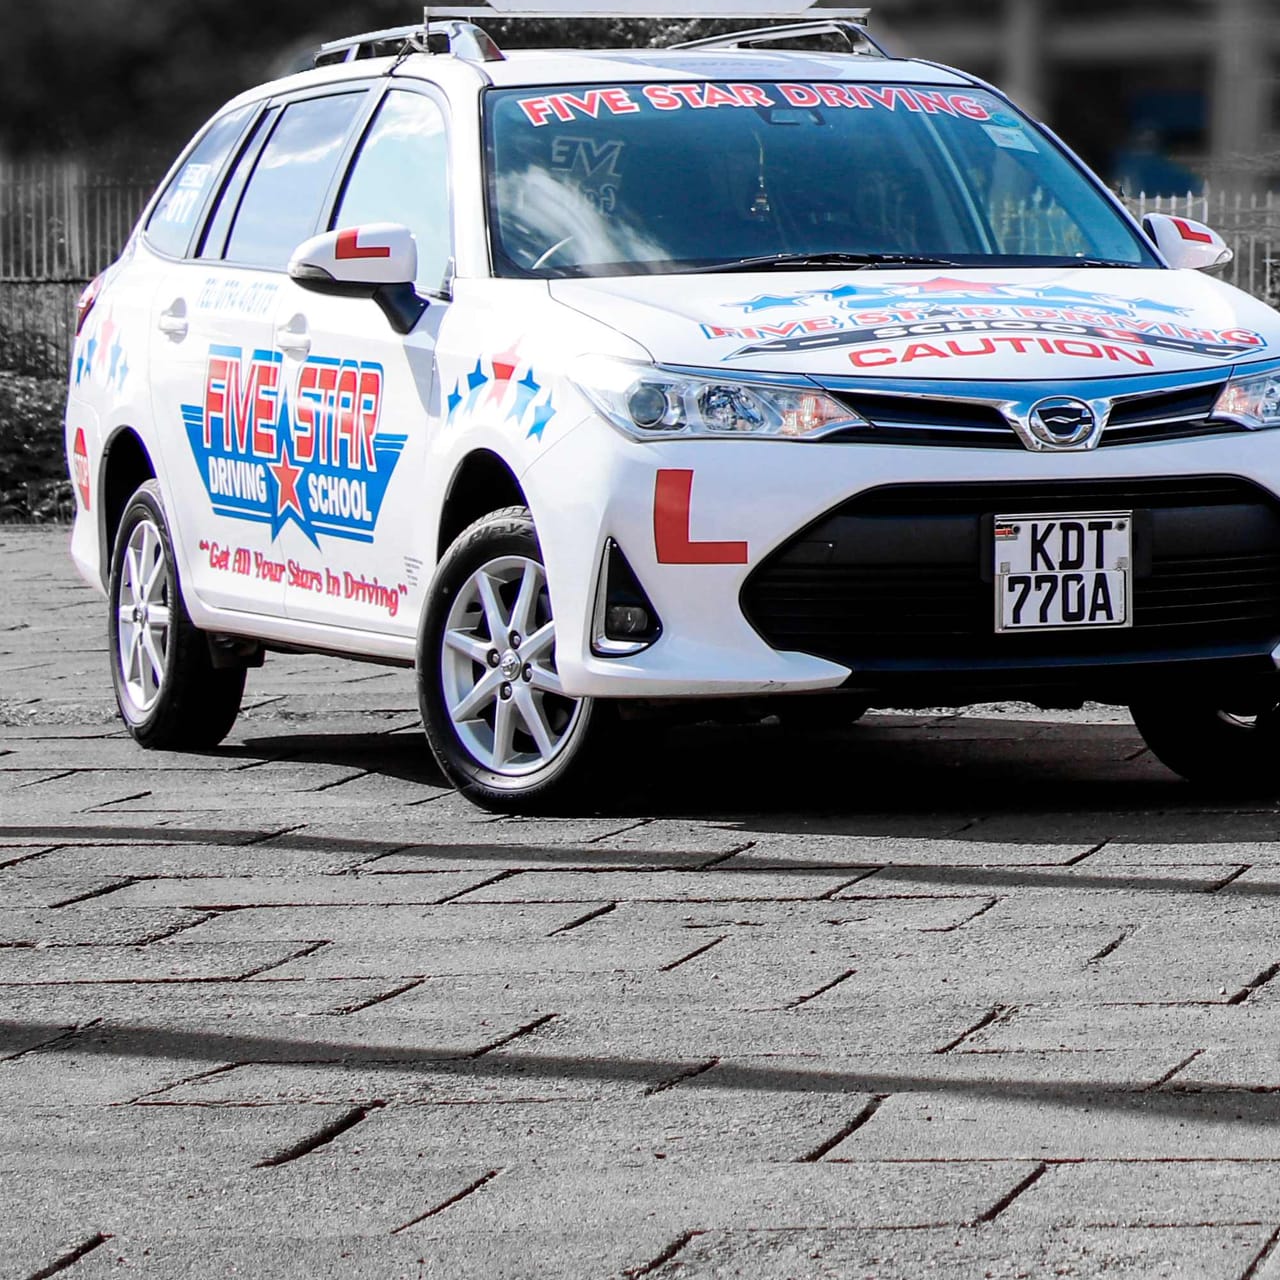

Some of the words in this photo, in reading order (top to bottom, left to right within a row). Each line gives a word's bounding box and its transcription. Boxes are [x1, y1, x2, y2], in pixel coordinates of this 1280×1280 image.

[517, 88, 640, 127] FIVE
[642, 83, 775, 110] STAR
[776, 82, 991, 121] DRIVING
[335, 228, 390, 259] L
[1171, 219, 1213, 245] L
[700, 314, 838, 340] FIVE
[1013, 307, 1267, 347] DRIVING
[874, 319, 1145, 343] SCHOOL
[849, 336, 1154, 368] CAUTION
[203, 350, 283, 459] FIVE
[293, 360, 383, 472] STAR
[208, 456, 267, 504] DRIVING
[308, 473, 372, 522] SCHOOL
[653, 469, 748, 564] L
[232, 547, 250, 575] All
[254, 551, 286, 583] Your
[1031, 521, 1113, 571] KDT
[1008, 573, 1114, 624] 770A
